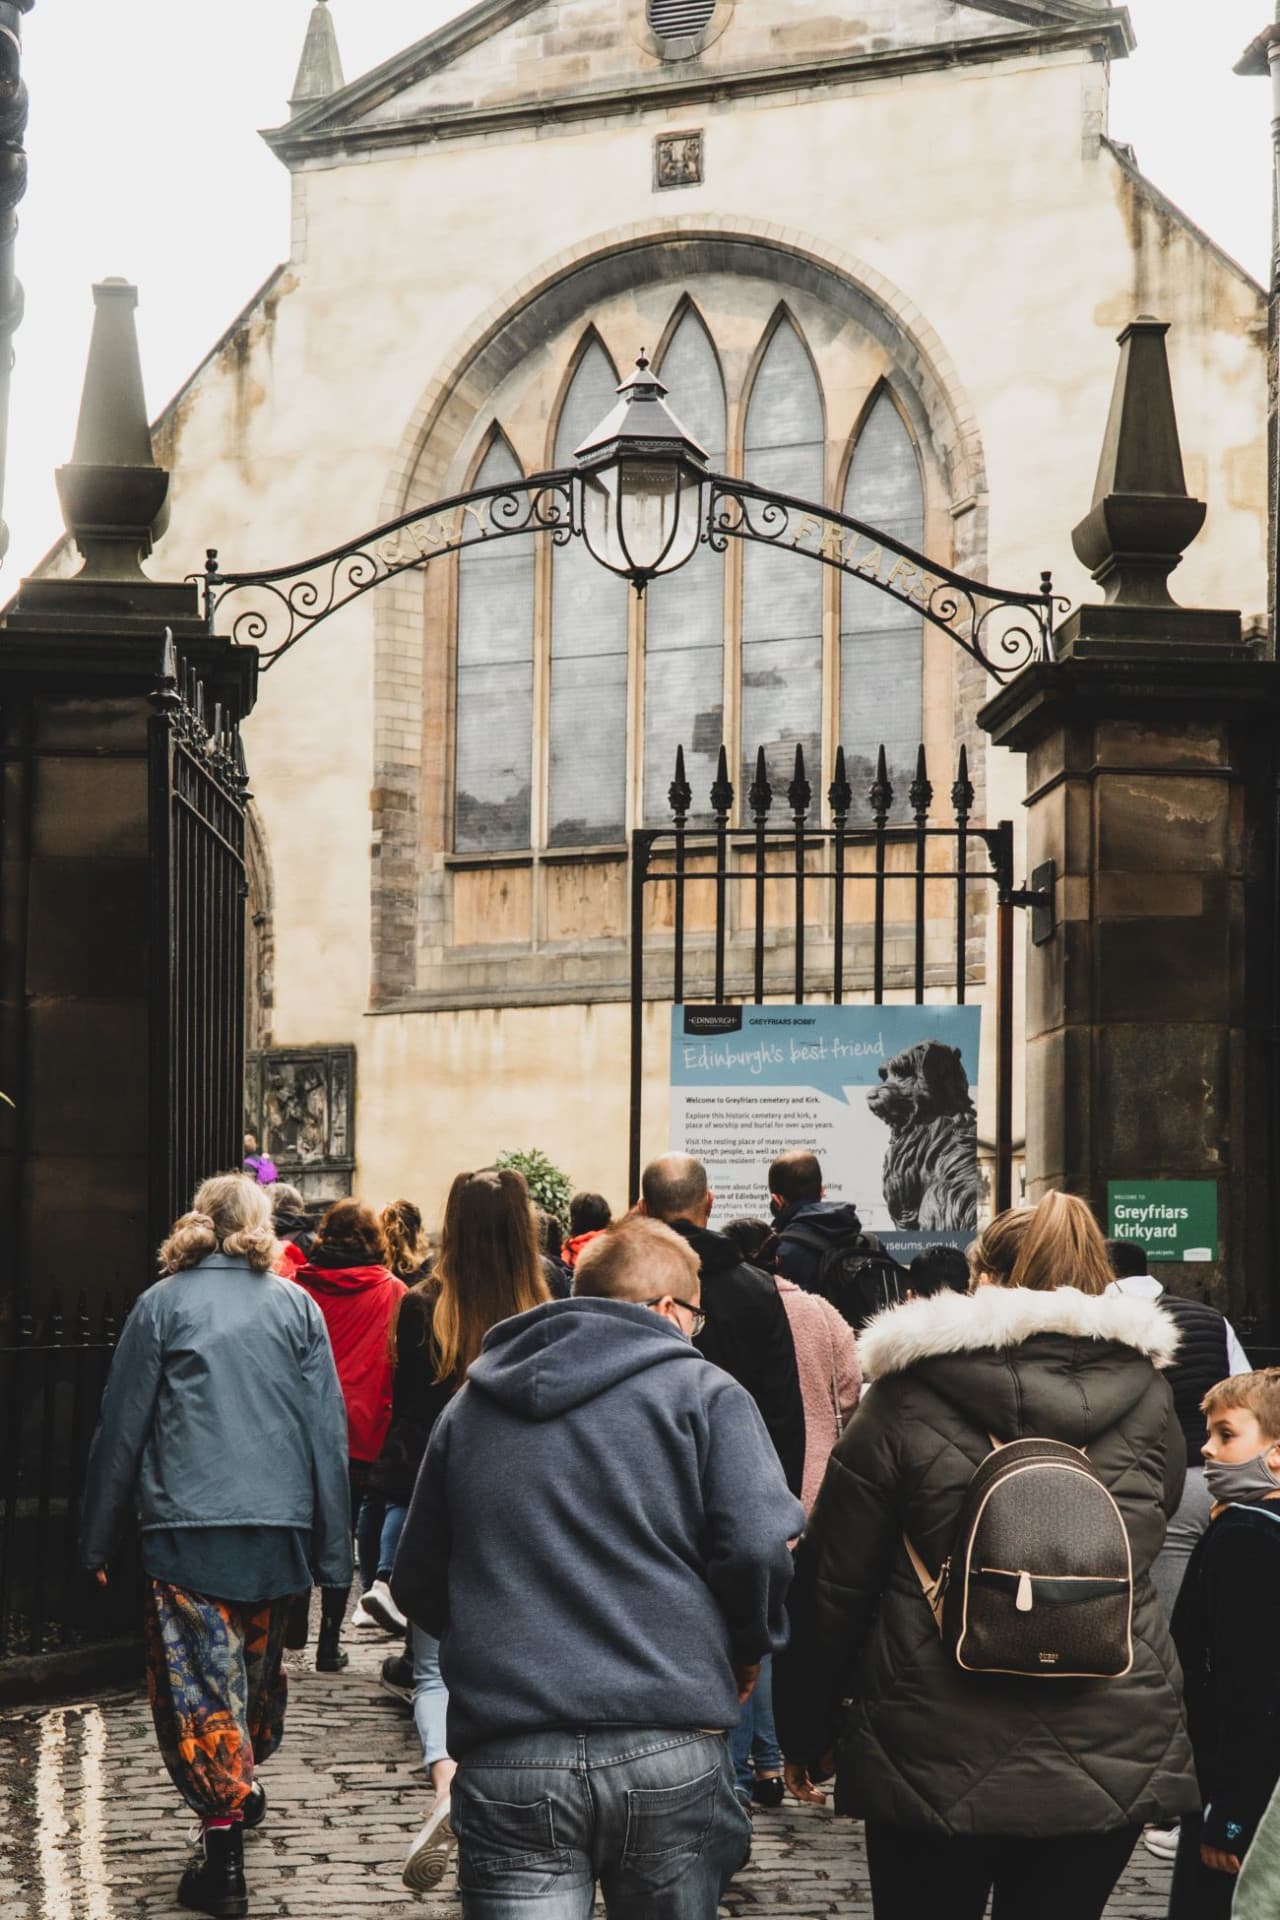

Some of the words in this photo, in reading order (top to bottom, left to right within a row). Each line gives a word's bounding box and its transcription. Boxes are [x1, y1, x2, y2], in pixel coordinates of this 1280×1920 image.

[792, 513, 940, 602] FRIARS
[682, 1042, 784, 1075] Edinburgh's
[790, 1035, 828, 1064] best
[832, 1032, 885, 1060] friend
[685, 1096, 716, 1104] Welcome
[725, 1096, 758, 1105] Greyfriars
[759, 1097, 790, 1105] cemetery
[791, 1096, 804, 1104] and
[805, 1096, 820, 1104] Kirk.
[685, 1112, 710, 1121] Explore
[751, 1113, 782, 1121] cemetery
[685, 1122, 703, 1130] place
[704, 1121, 712, 1129] of
[712, 1122, 739, 1130] worship
[740, 1121, 753, 1129] and
[754, 1121, 773, 1129] burial
[774, 1121, 784, 1129] for
[713, 1138, 737, 1147] resting
[738, 1138, 755, 1147] place
[765, 1139, 783, 1147] many
[784, 1138, 817, 1147] important
[755, 1147, 769, 1155] well
[732, 1183, 752, 1191] about
[735, 1193, 769, 1201] Edinburgh
[1114, 1204, 1189, 1223] Greyfriars
[1114, 1223, 1178, 1242] Kirkyard
